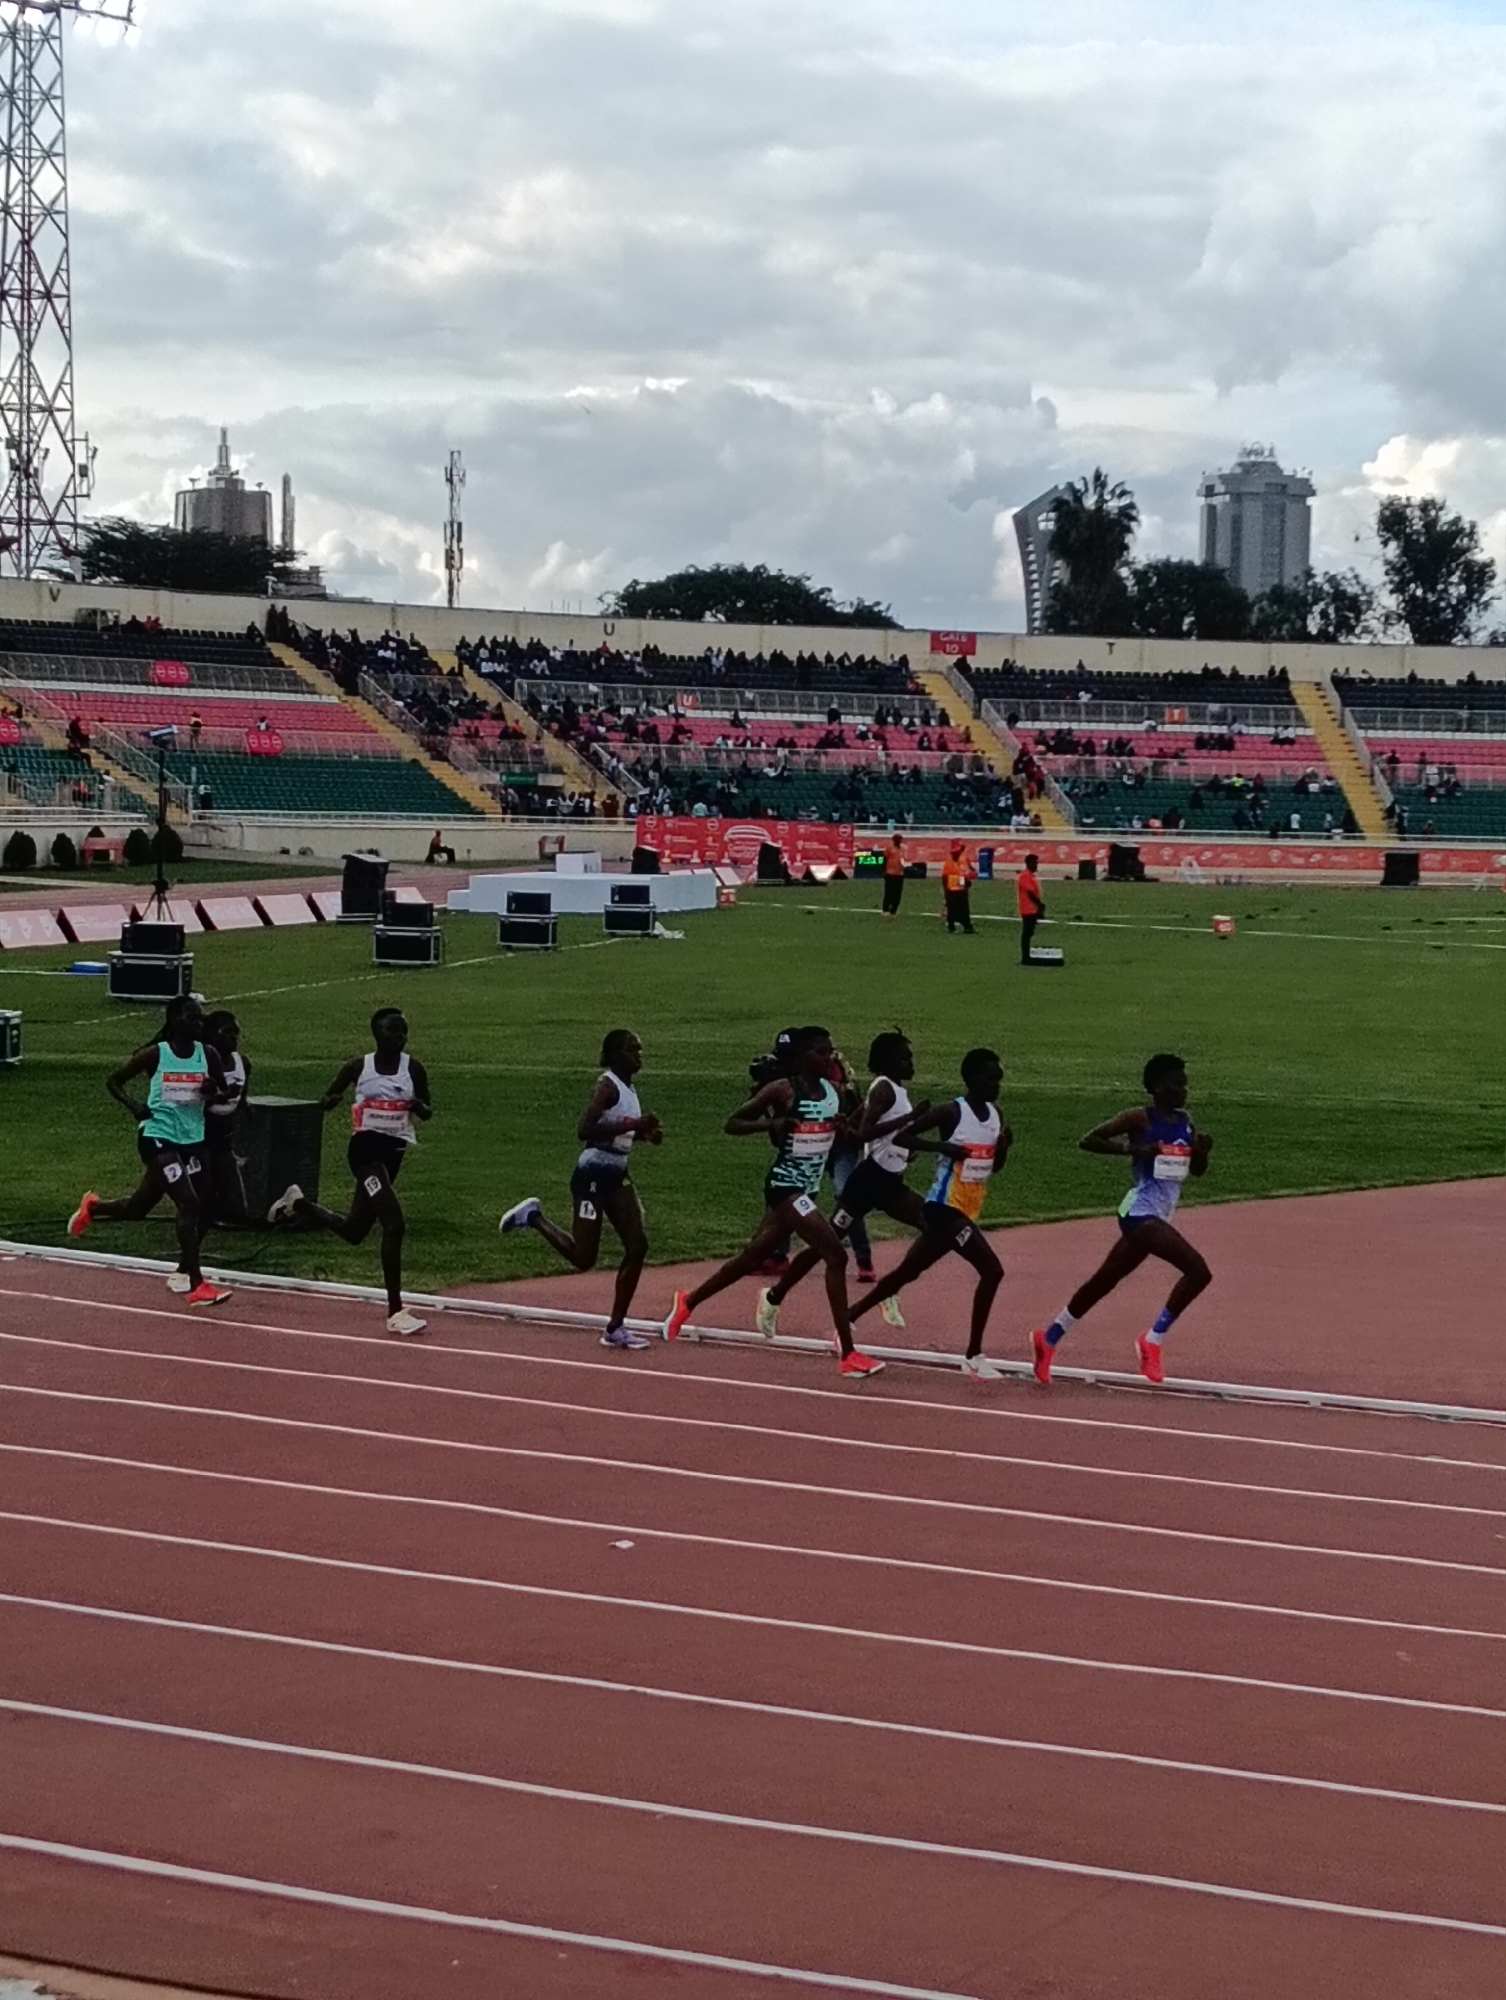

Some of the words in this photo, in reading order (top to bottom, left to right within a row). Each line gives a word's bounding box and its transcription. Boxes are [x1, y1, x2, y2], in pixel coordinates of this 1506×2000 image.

[49, 587, 61, 602] V
[603, 622, 616, 637] U
[945, 643, 959, 653] 10
[1106, 642, 1116, 655] T
[682, 694, 693, 707] U
[364, 1177, 379, 1193] 19
[799, 1199, 810, 1210] 9
